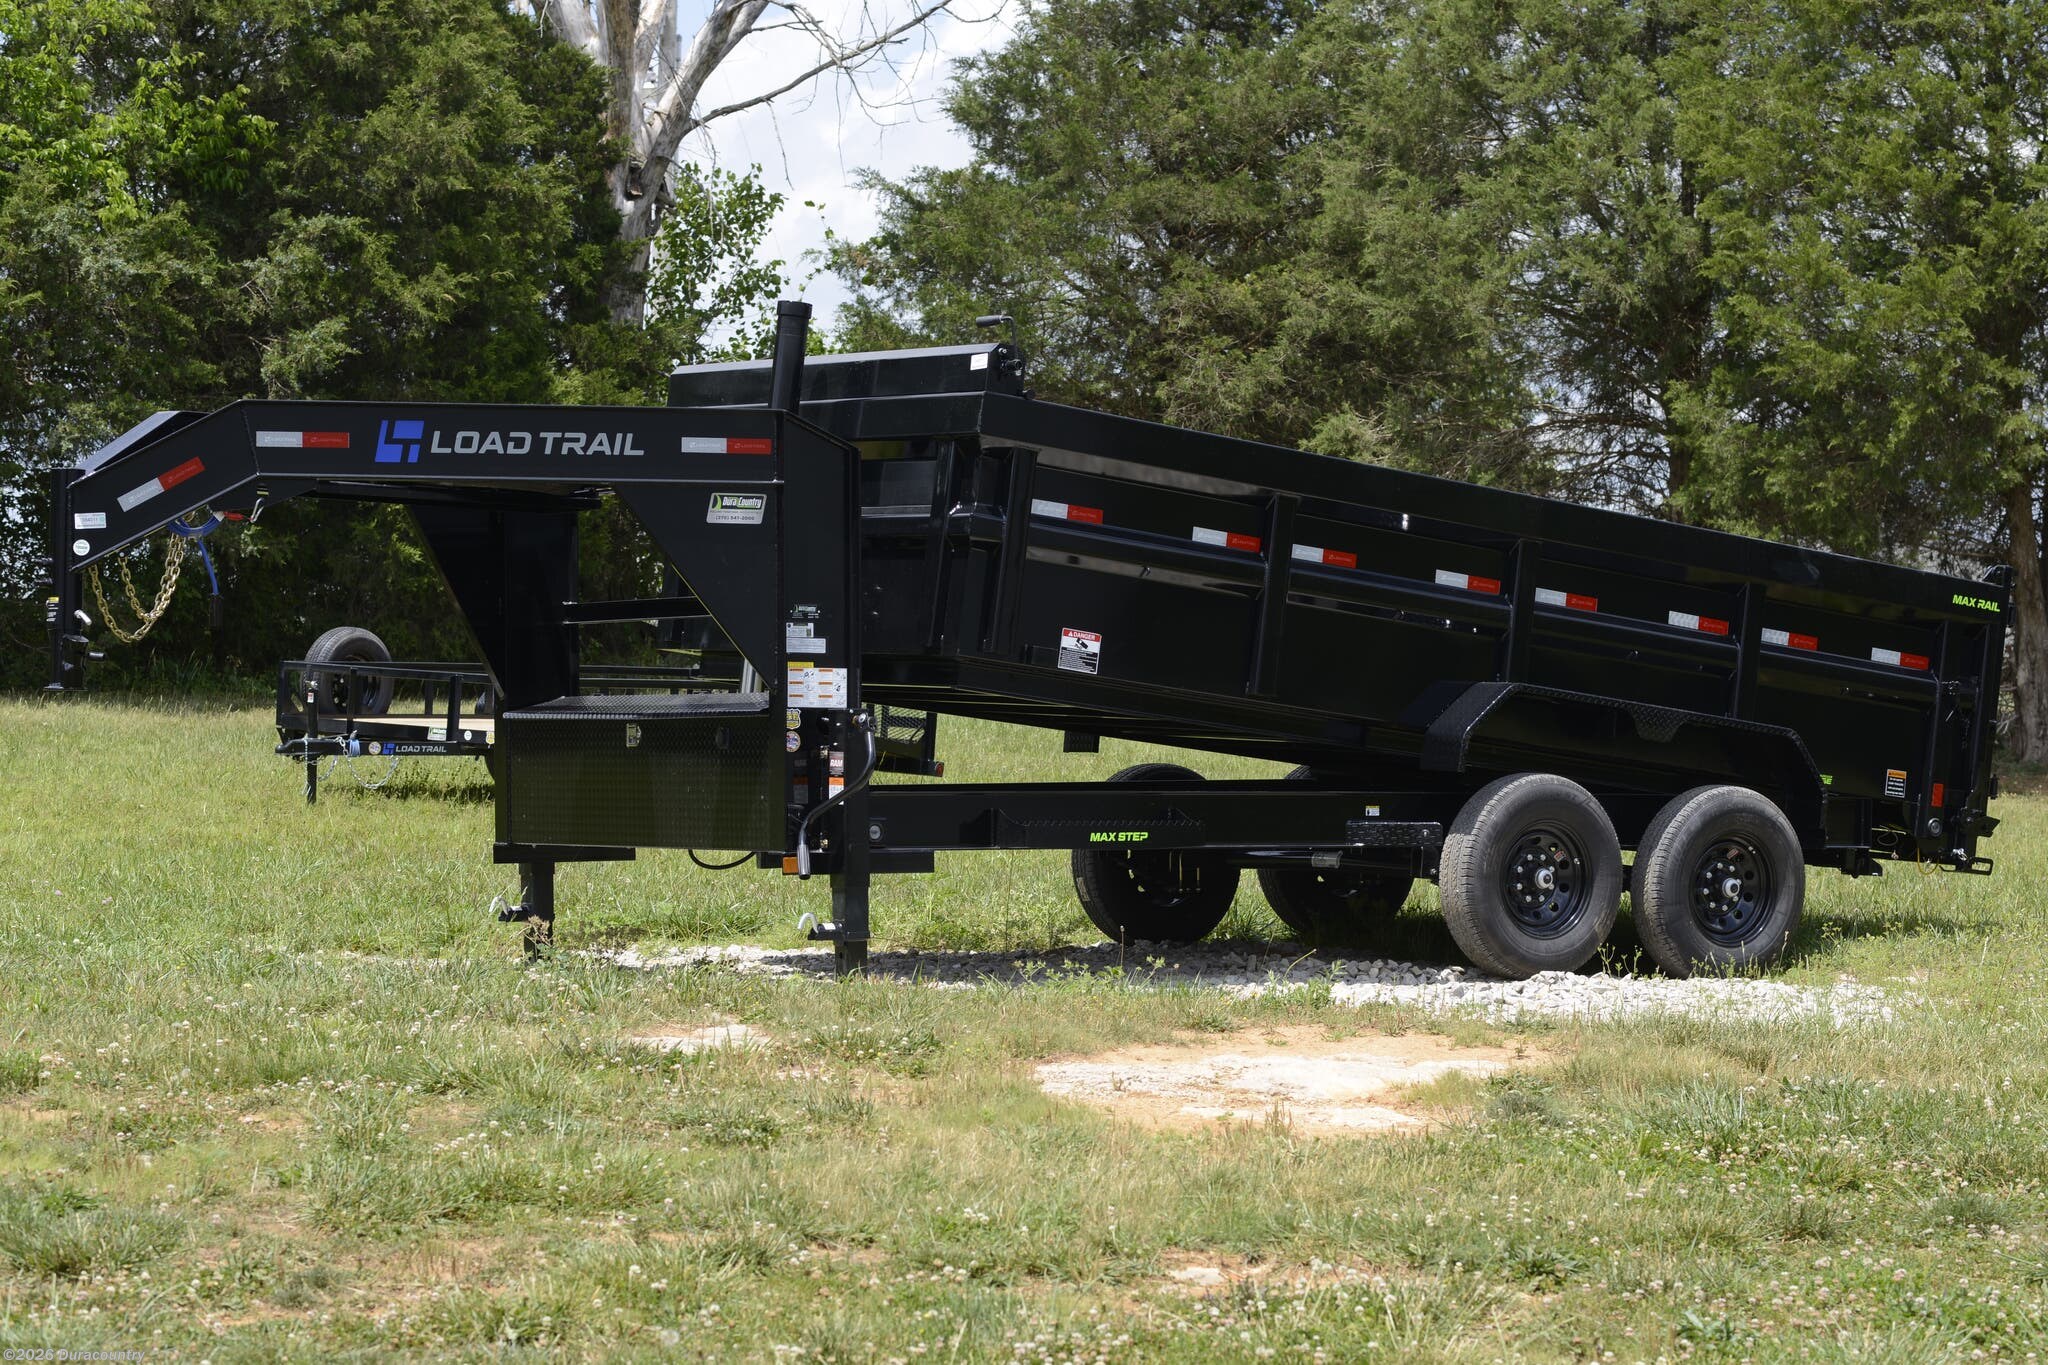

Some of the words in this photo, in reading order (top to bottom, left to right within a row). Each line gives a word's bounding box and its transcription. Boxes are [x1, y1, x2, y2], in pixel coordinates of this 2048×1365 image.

[431, 431, 532, 454] LOAD
[539, 432, 645, 456] TRAIL
[722, 496, 737, 506] Dura
[738, 497, 762, 509] Country
[1952, 594, 1977, 608] MAX
[1977, 599, 2001, 612] RAIL
[1073, 631, 1096, 641] DANGER
[395, 745, 420, 753] LOAD
[421, 745, 447, 753] TRAIL
[829, 759, 844, 767] RAM
[1089, 832, 1117, 842] MAX
[1117, 831, 1149, 842] STEP
